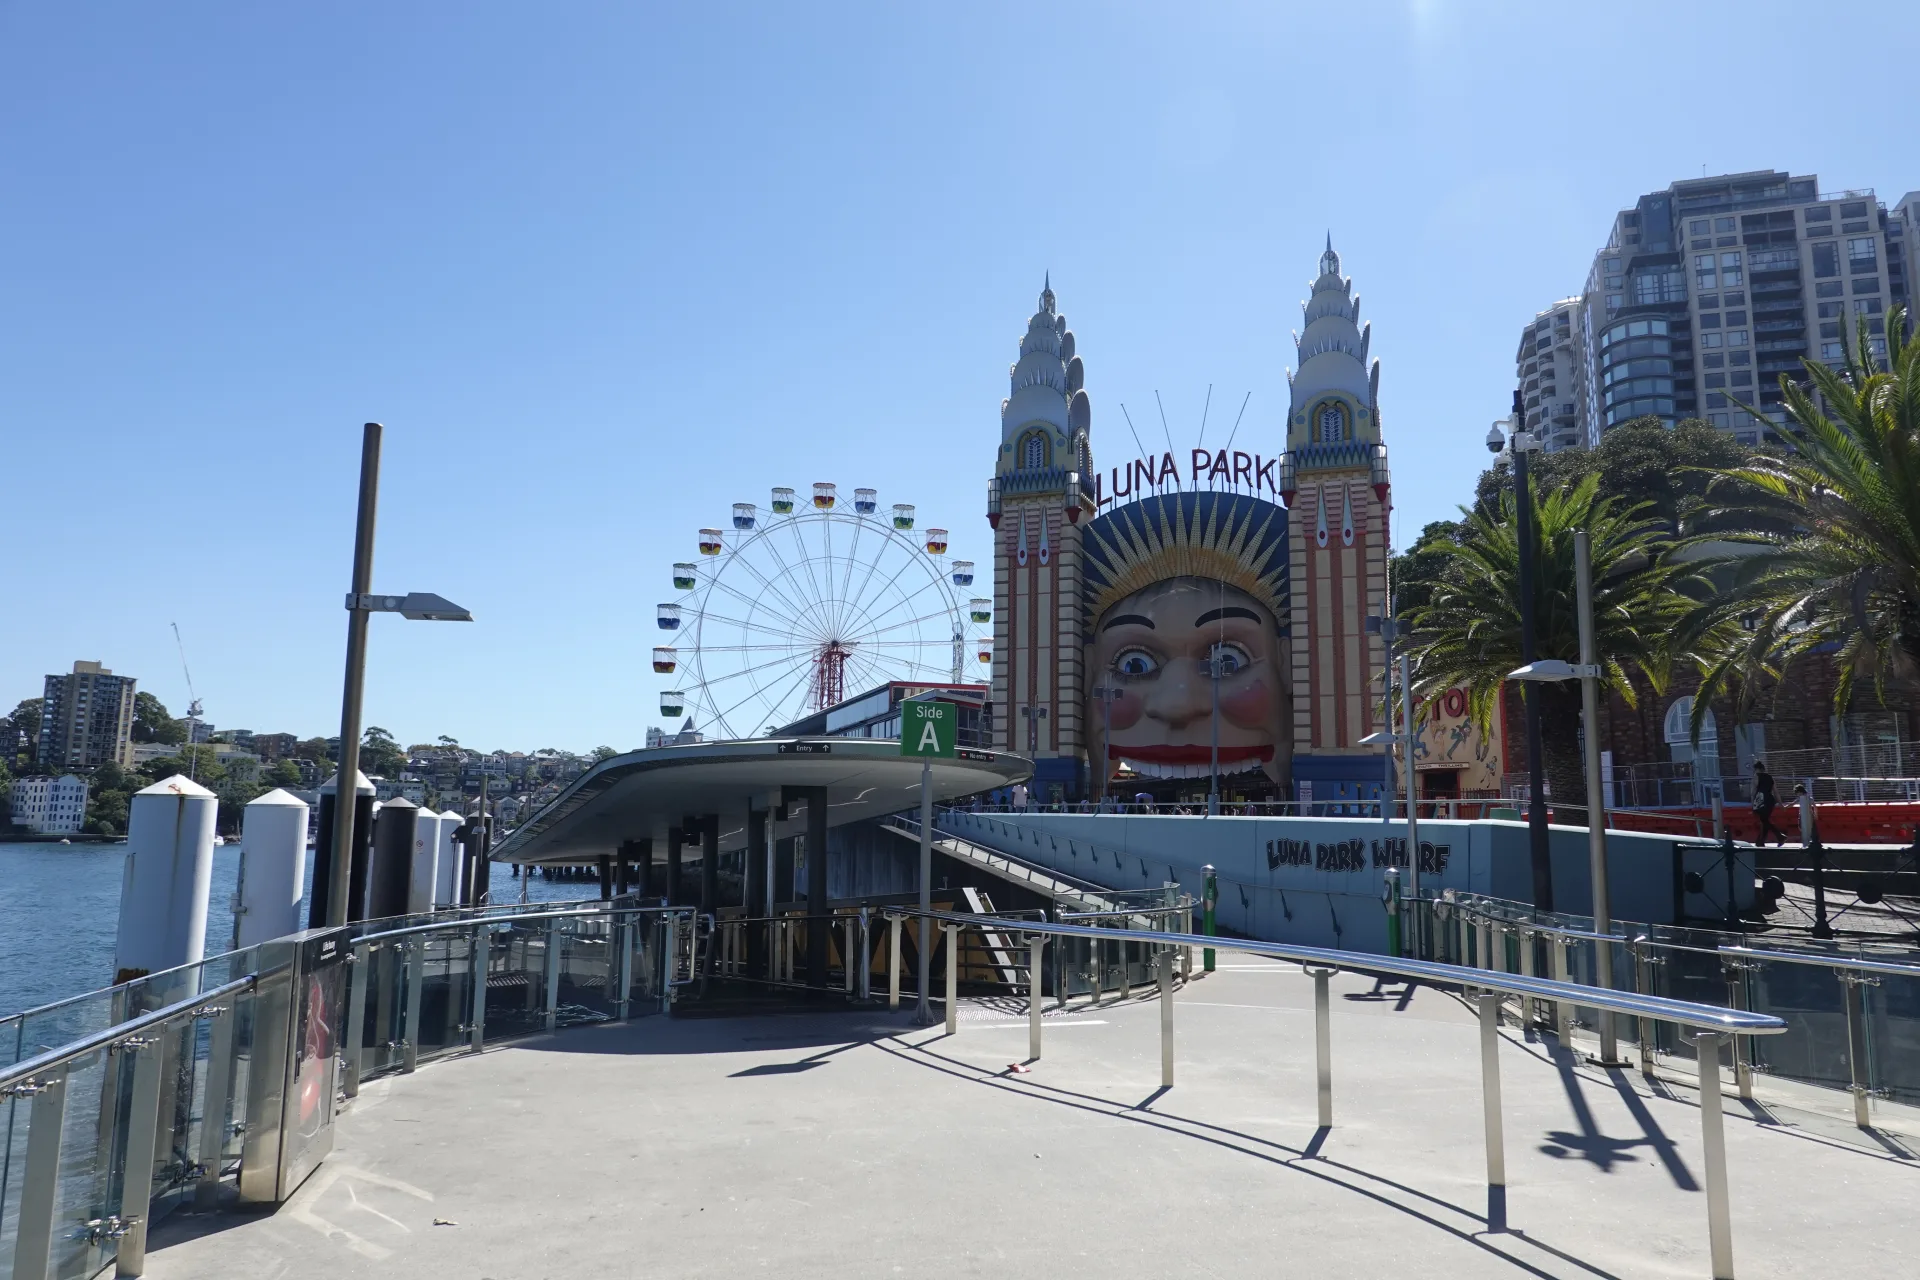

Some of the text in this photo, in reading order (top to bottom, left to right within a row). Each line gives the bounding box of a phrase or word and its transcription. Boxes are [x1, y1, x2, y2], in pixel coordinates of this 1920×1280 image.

[1096, 449, 1277, 507] LUNA PARK
[916, 705, 943, 719] Side
[796, 745, 813, 753] Entry
[917, 721, 941, 752] A
[1266, 837, 1312, 871] LUNA
[1316, 837, 1367, 872] PARK
